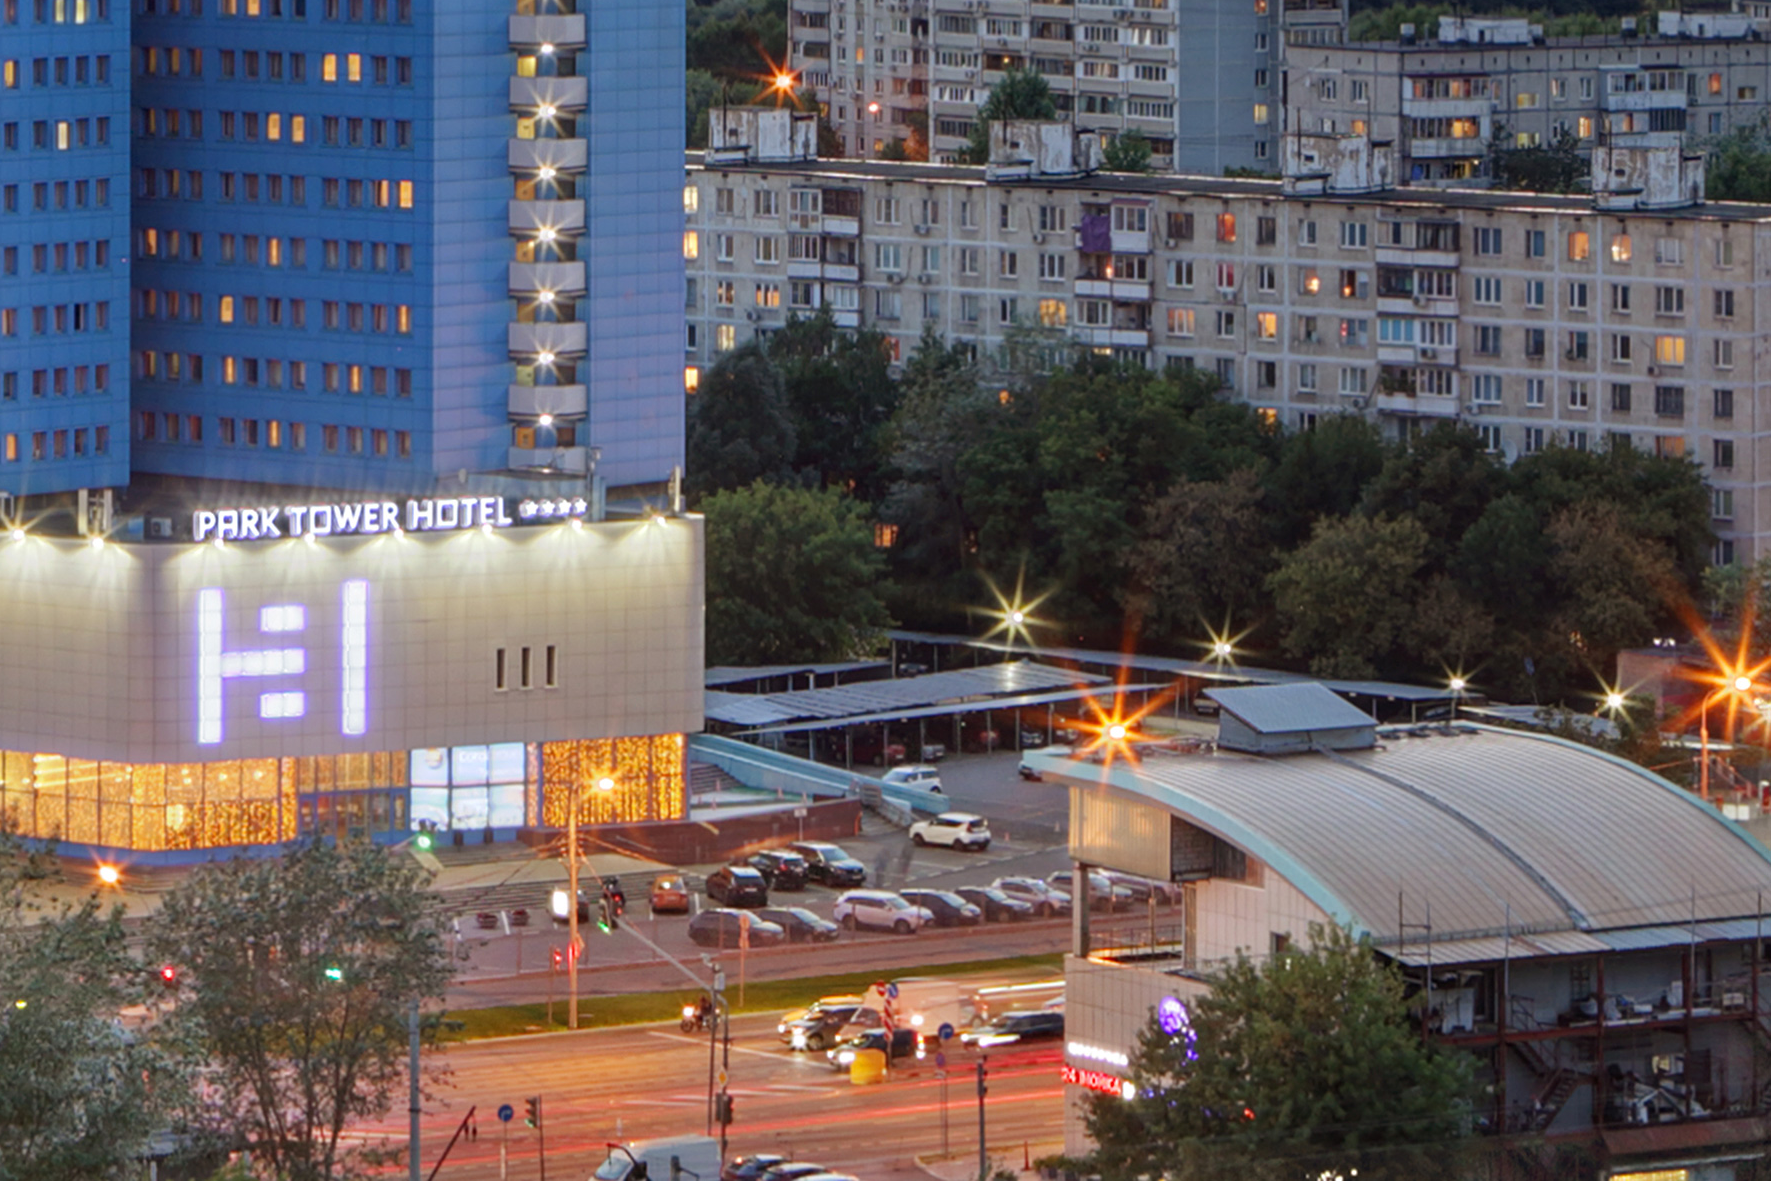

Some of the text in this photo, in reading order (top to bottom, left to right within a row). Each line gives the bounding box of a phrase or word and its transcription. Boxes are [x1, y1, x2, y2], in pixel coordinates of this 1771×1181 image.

[194, 496, 513, 542] PARK TOWER HOTEL
